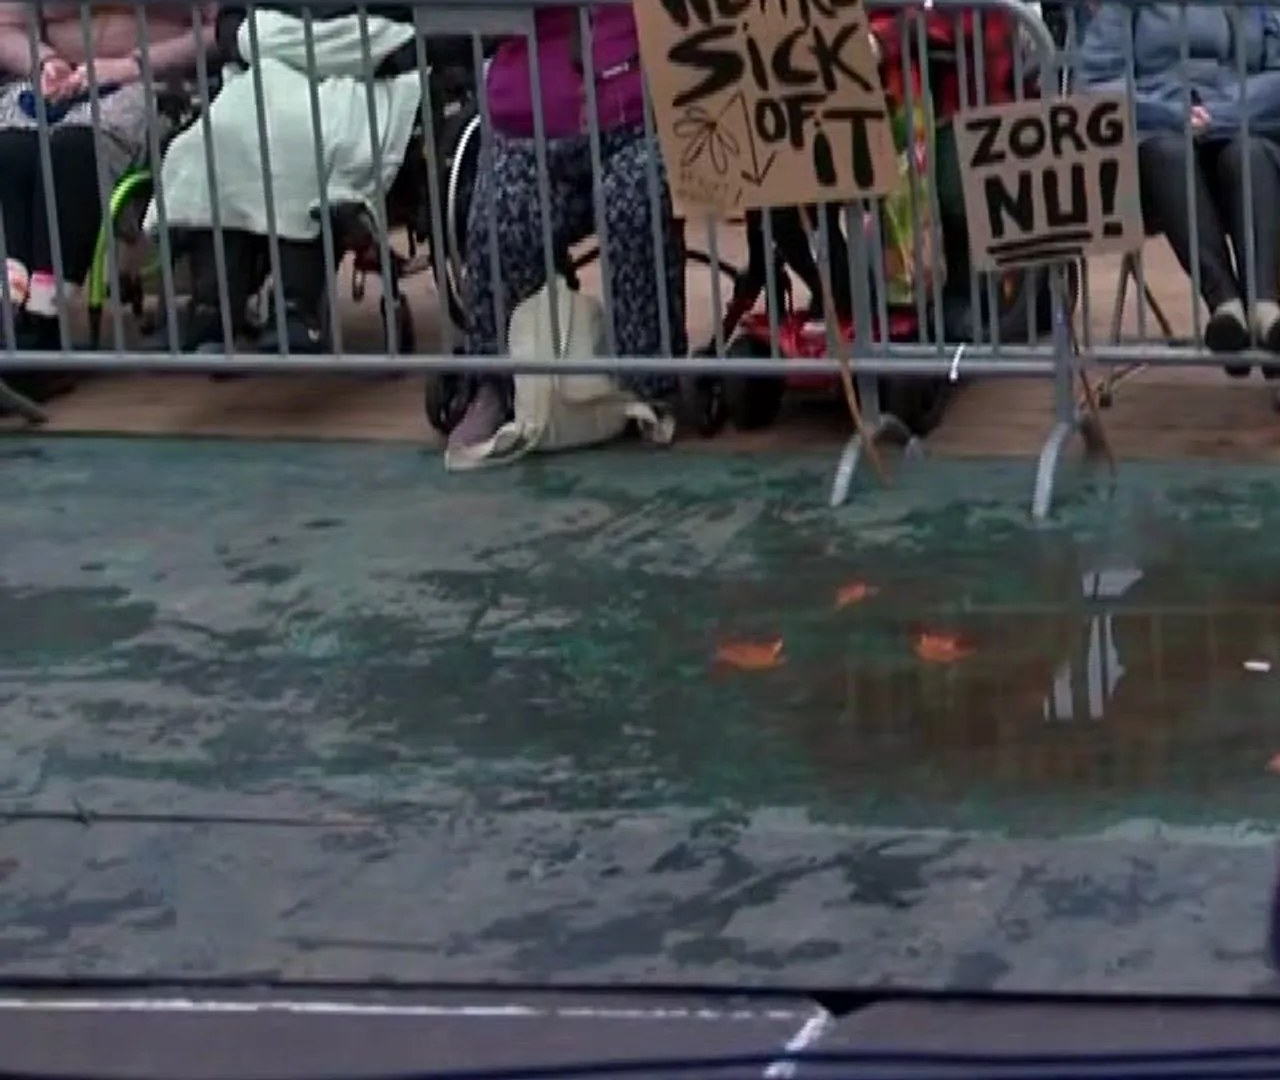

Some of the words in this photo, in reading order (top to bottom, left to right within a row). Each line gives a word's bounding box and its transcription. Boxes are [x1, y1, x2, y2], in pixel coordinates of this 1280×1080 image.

[755, 92, 828, 149] OF
[964, 101, 1125, 169] ZORG
[983, 157, 1120, 239] NU!
